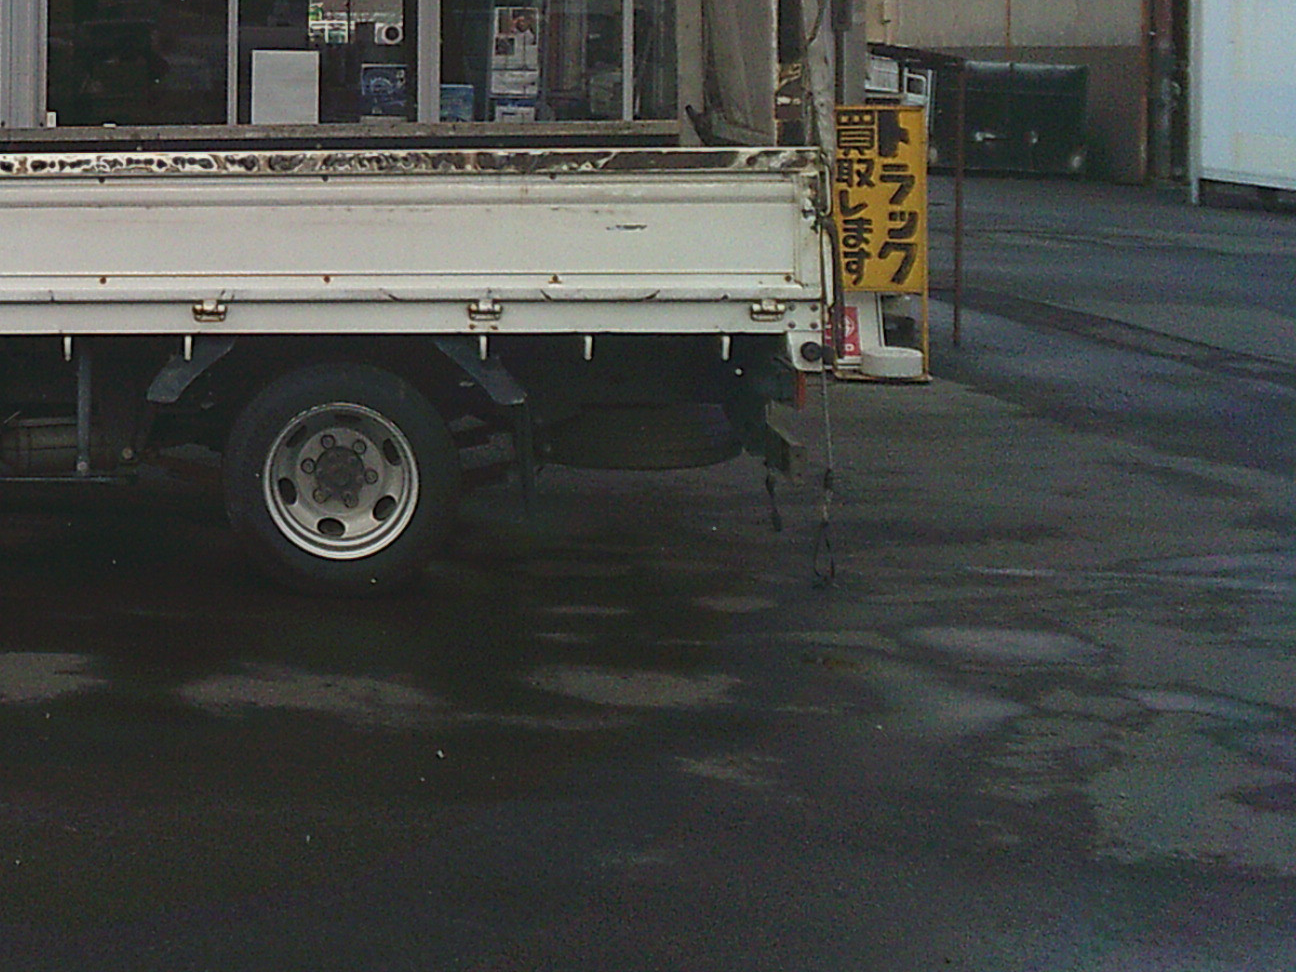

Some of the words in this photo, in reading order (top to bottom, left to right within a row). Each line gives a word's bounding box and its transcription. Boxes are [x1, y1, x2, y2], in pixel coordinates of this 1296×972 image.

[835, 110, 875, 285] 買取します
[877, 110, 919, 285] トラック
